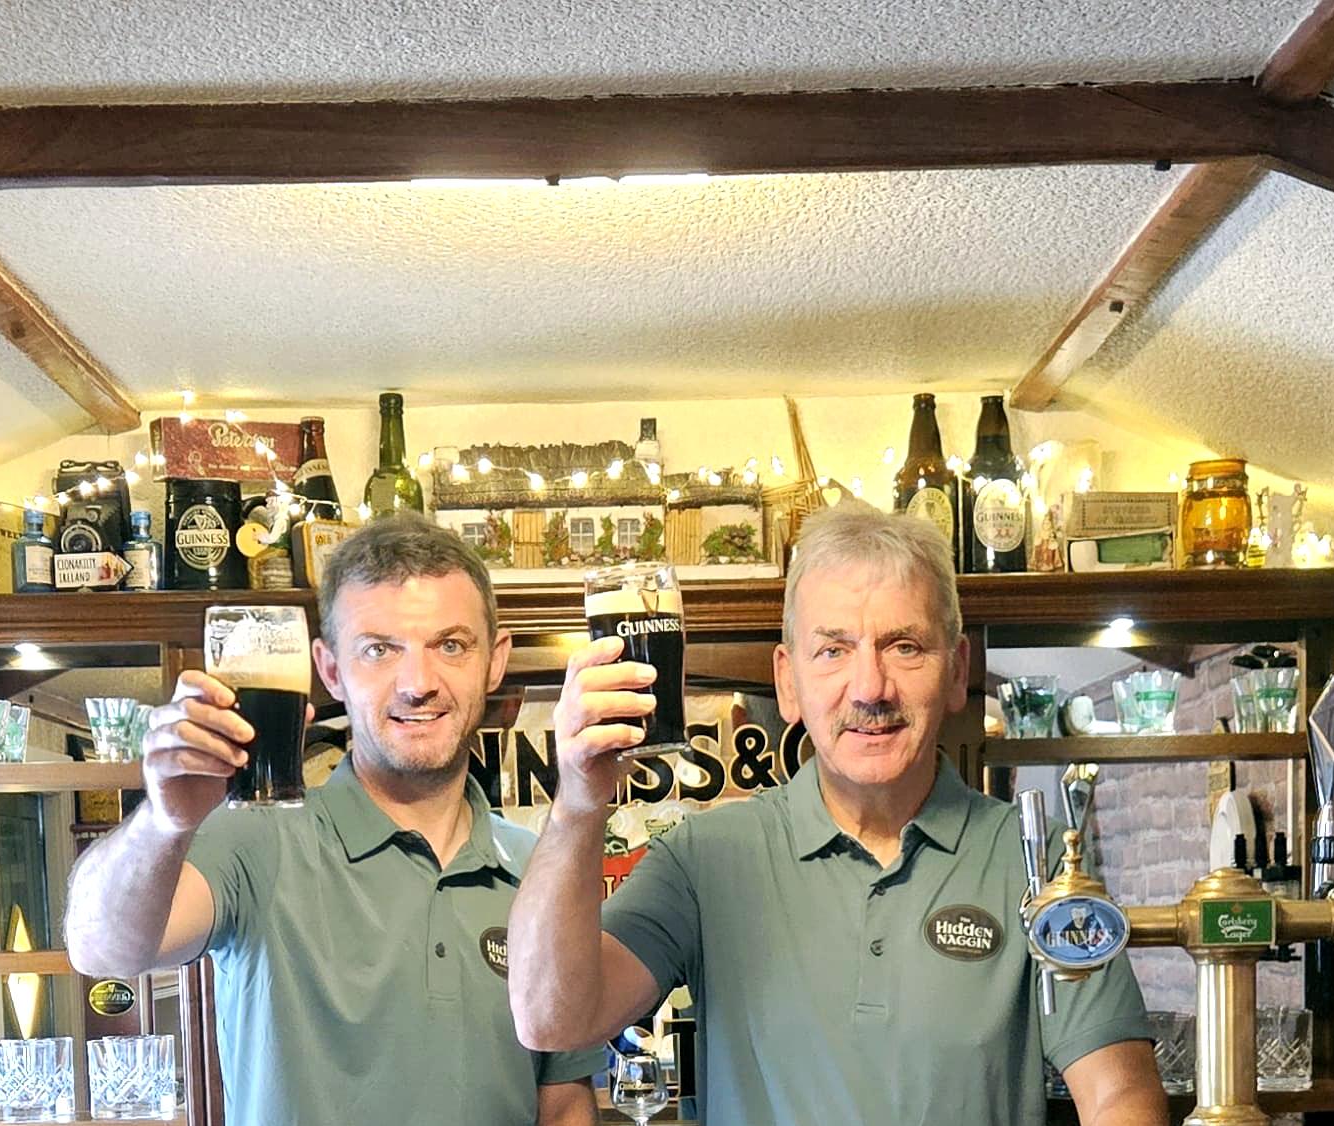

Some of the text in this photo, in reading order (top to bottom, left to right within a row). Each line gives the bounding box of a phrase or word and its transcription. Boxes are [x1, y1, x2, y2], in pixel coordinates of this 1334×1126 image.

[177, 532, 228, 545] GUINNESS
[59, 571, 91, 584] IRELAND
[616, 618, 681, 637] GUINNESS
[936, 934, 991, 949] NAGGIN
